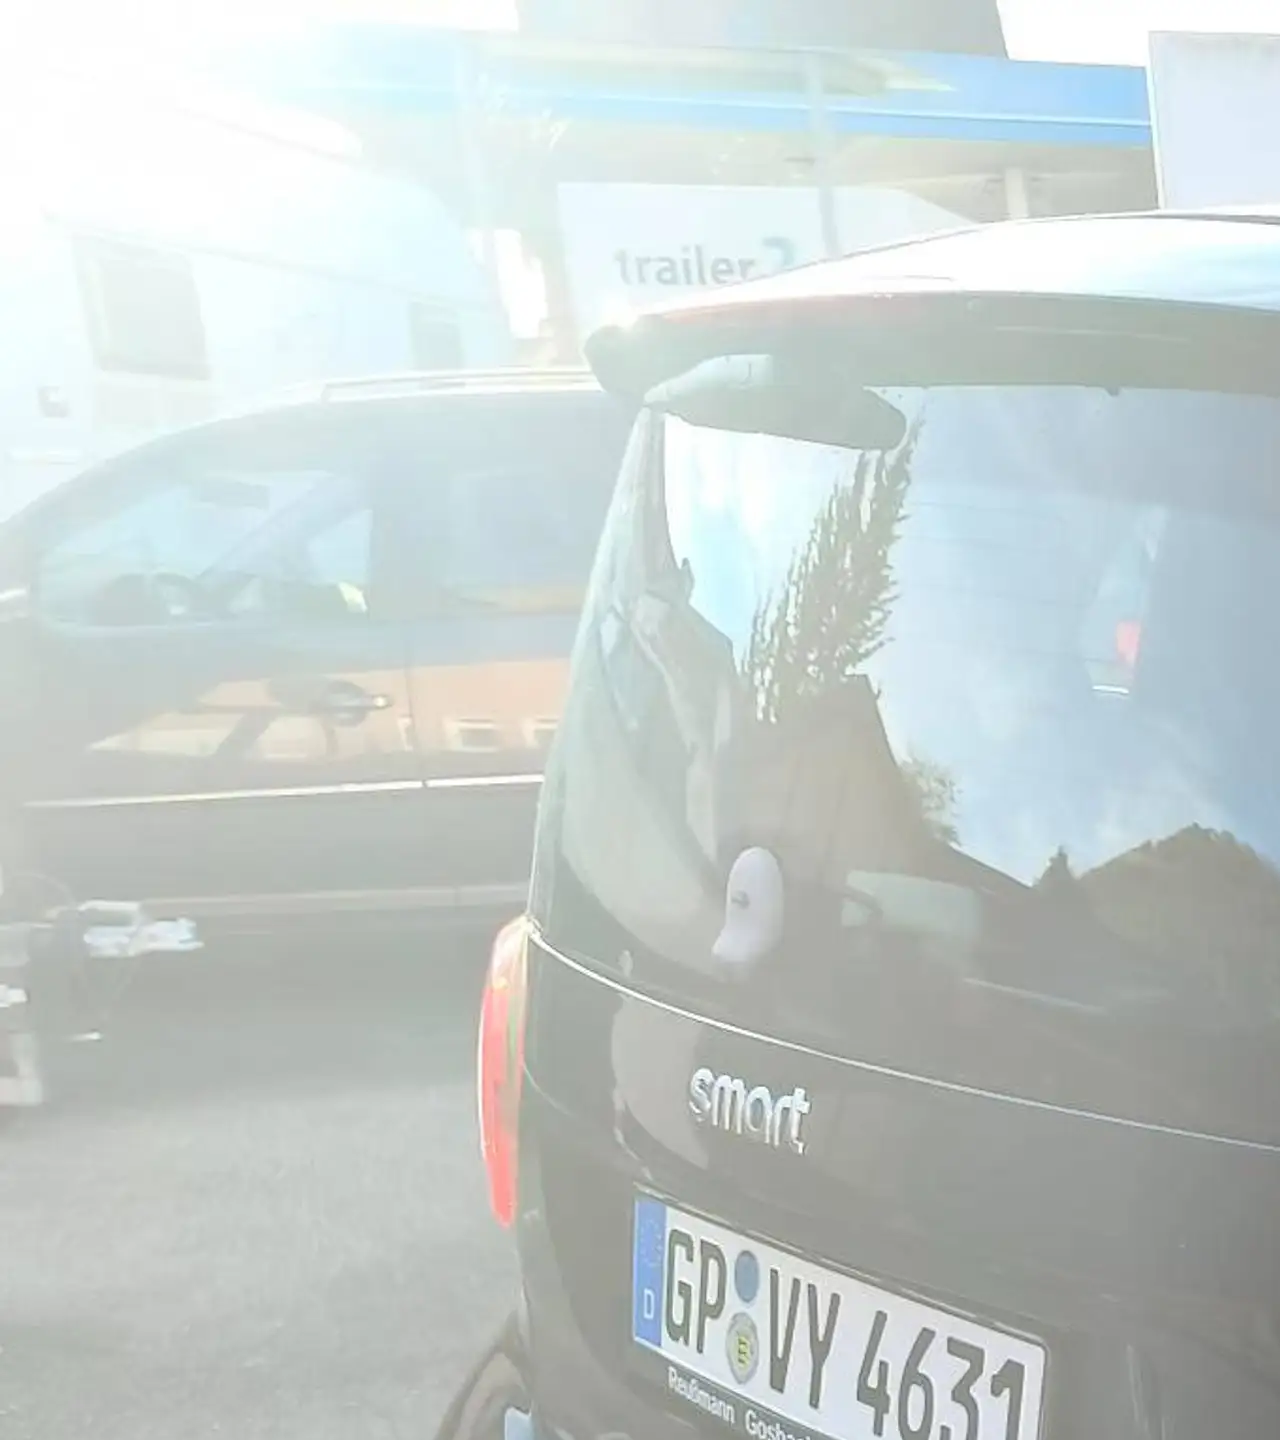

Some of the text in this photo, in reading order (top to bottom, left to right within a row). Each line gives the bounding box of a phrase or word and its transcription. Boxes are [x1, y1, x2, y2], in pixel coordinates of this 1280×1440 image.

[613, 244, 756, 286] trailer
[688, 1066, 811, 1155] smart
[643, 1287, 656, 1321] D
[665, 1228, 728, 1354] GP
[768, 1267, 842, 1411] VY
